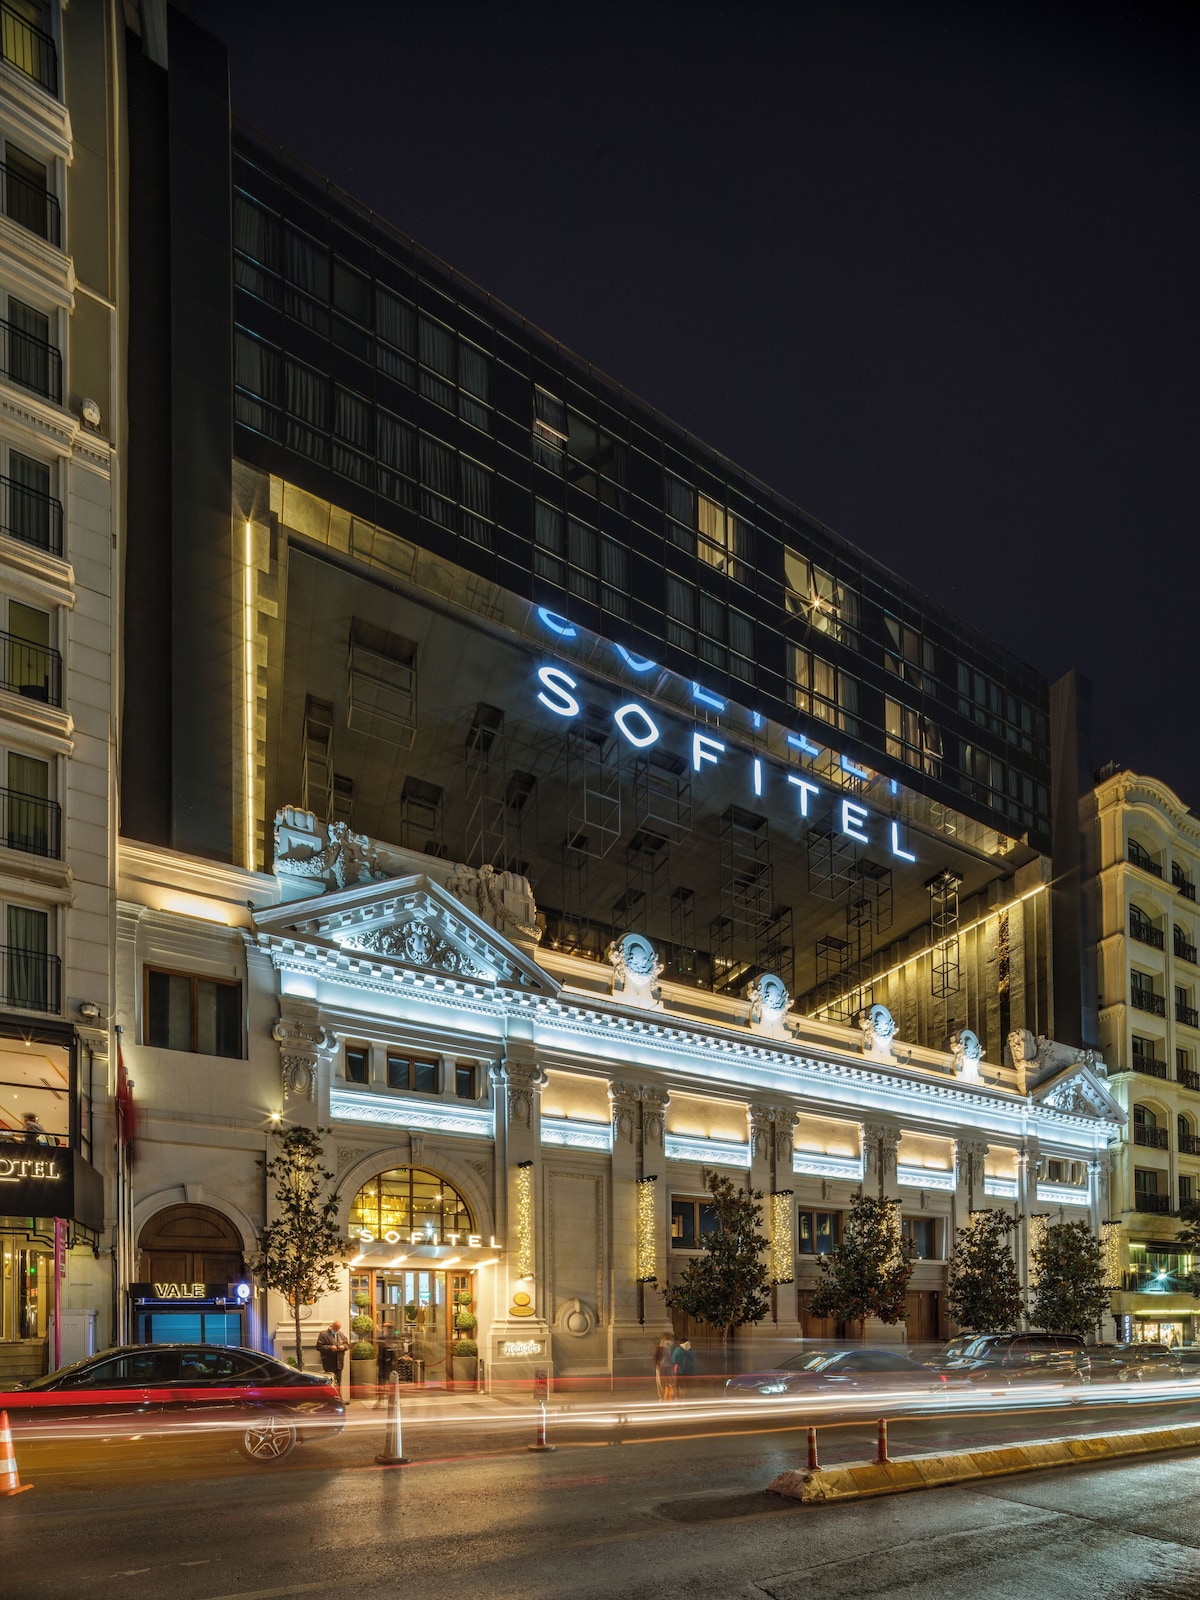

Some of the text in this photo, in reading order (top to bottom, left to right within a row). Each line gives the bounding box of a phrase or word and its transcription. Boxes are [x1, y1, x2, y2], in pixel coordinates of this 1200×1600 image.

[536, 665, 917, 863] SOFITEL
[360, 1229, 502, 1249] SOFITEL
[154, 1282, 206, 1299] VALE
